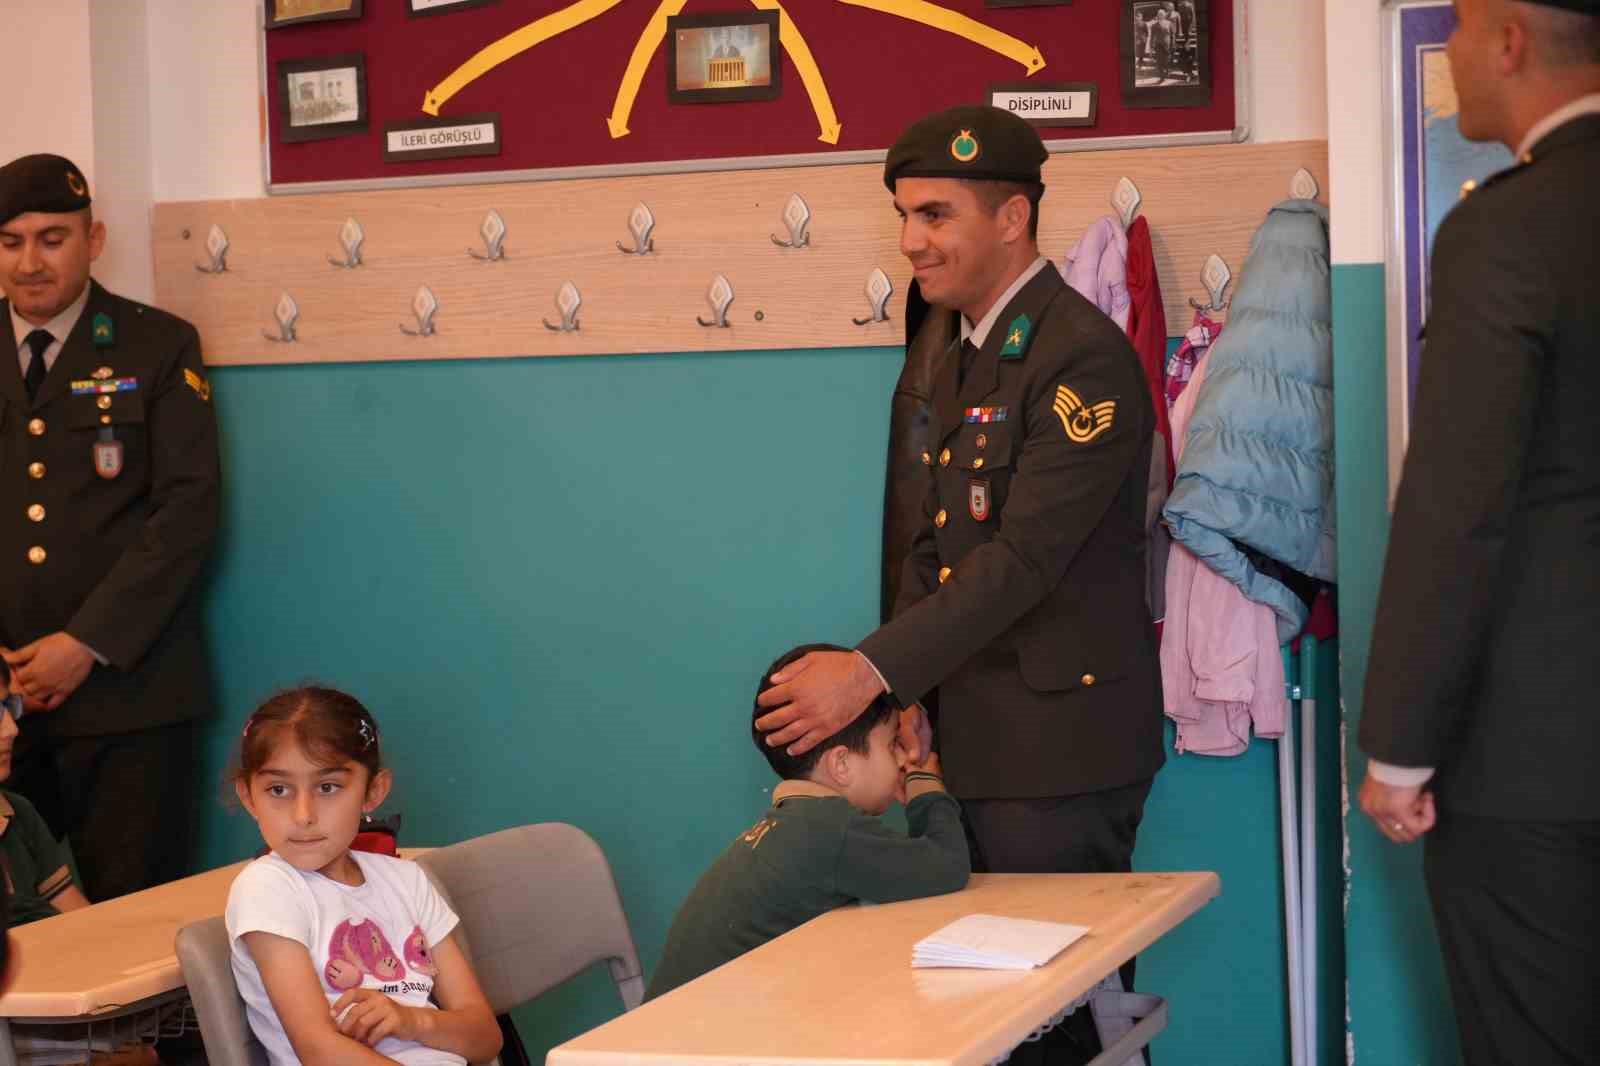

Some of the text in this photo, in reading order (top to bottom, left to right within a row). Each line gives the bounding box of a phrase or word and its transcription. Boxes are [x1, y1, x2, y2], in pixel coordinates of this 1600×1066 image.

[1008, 95, 1072, 111] DİSİPLİNLİ
[401, 127, 482, 147] İLERİ GÖRÜŞLÜ
